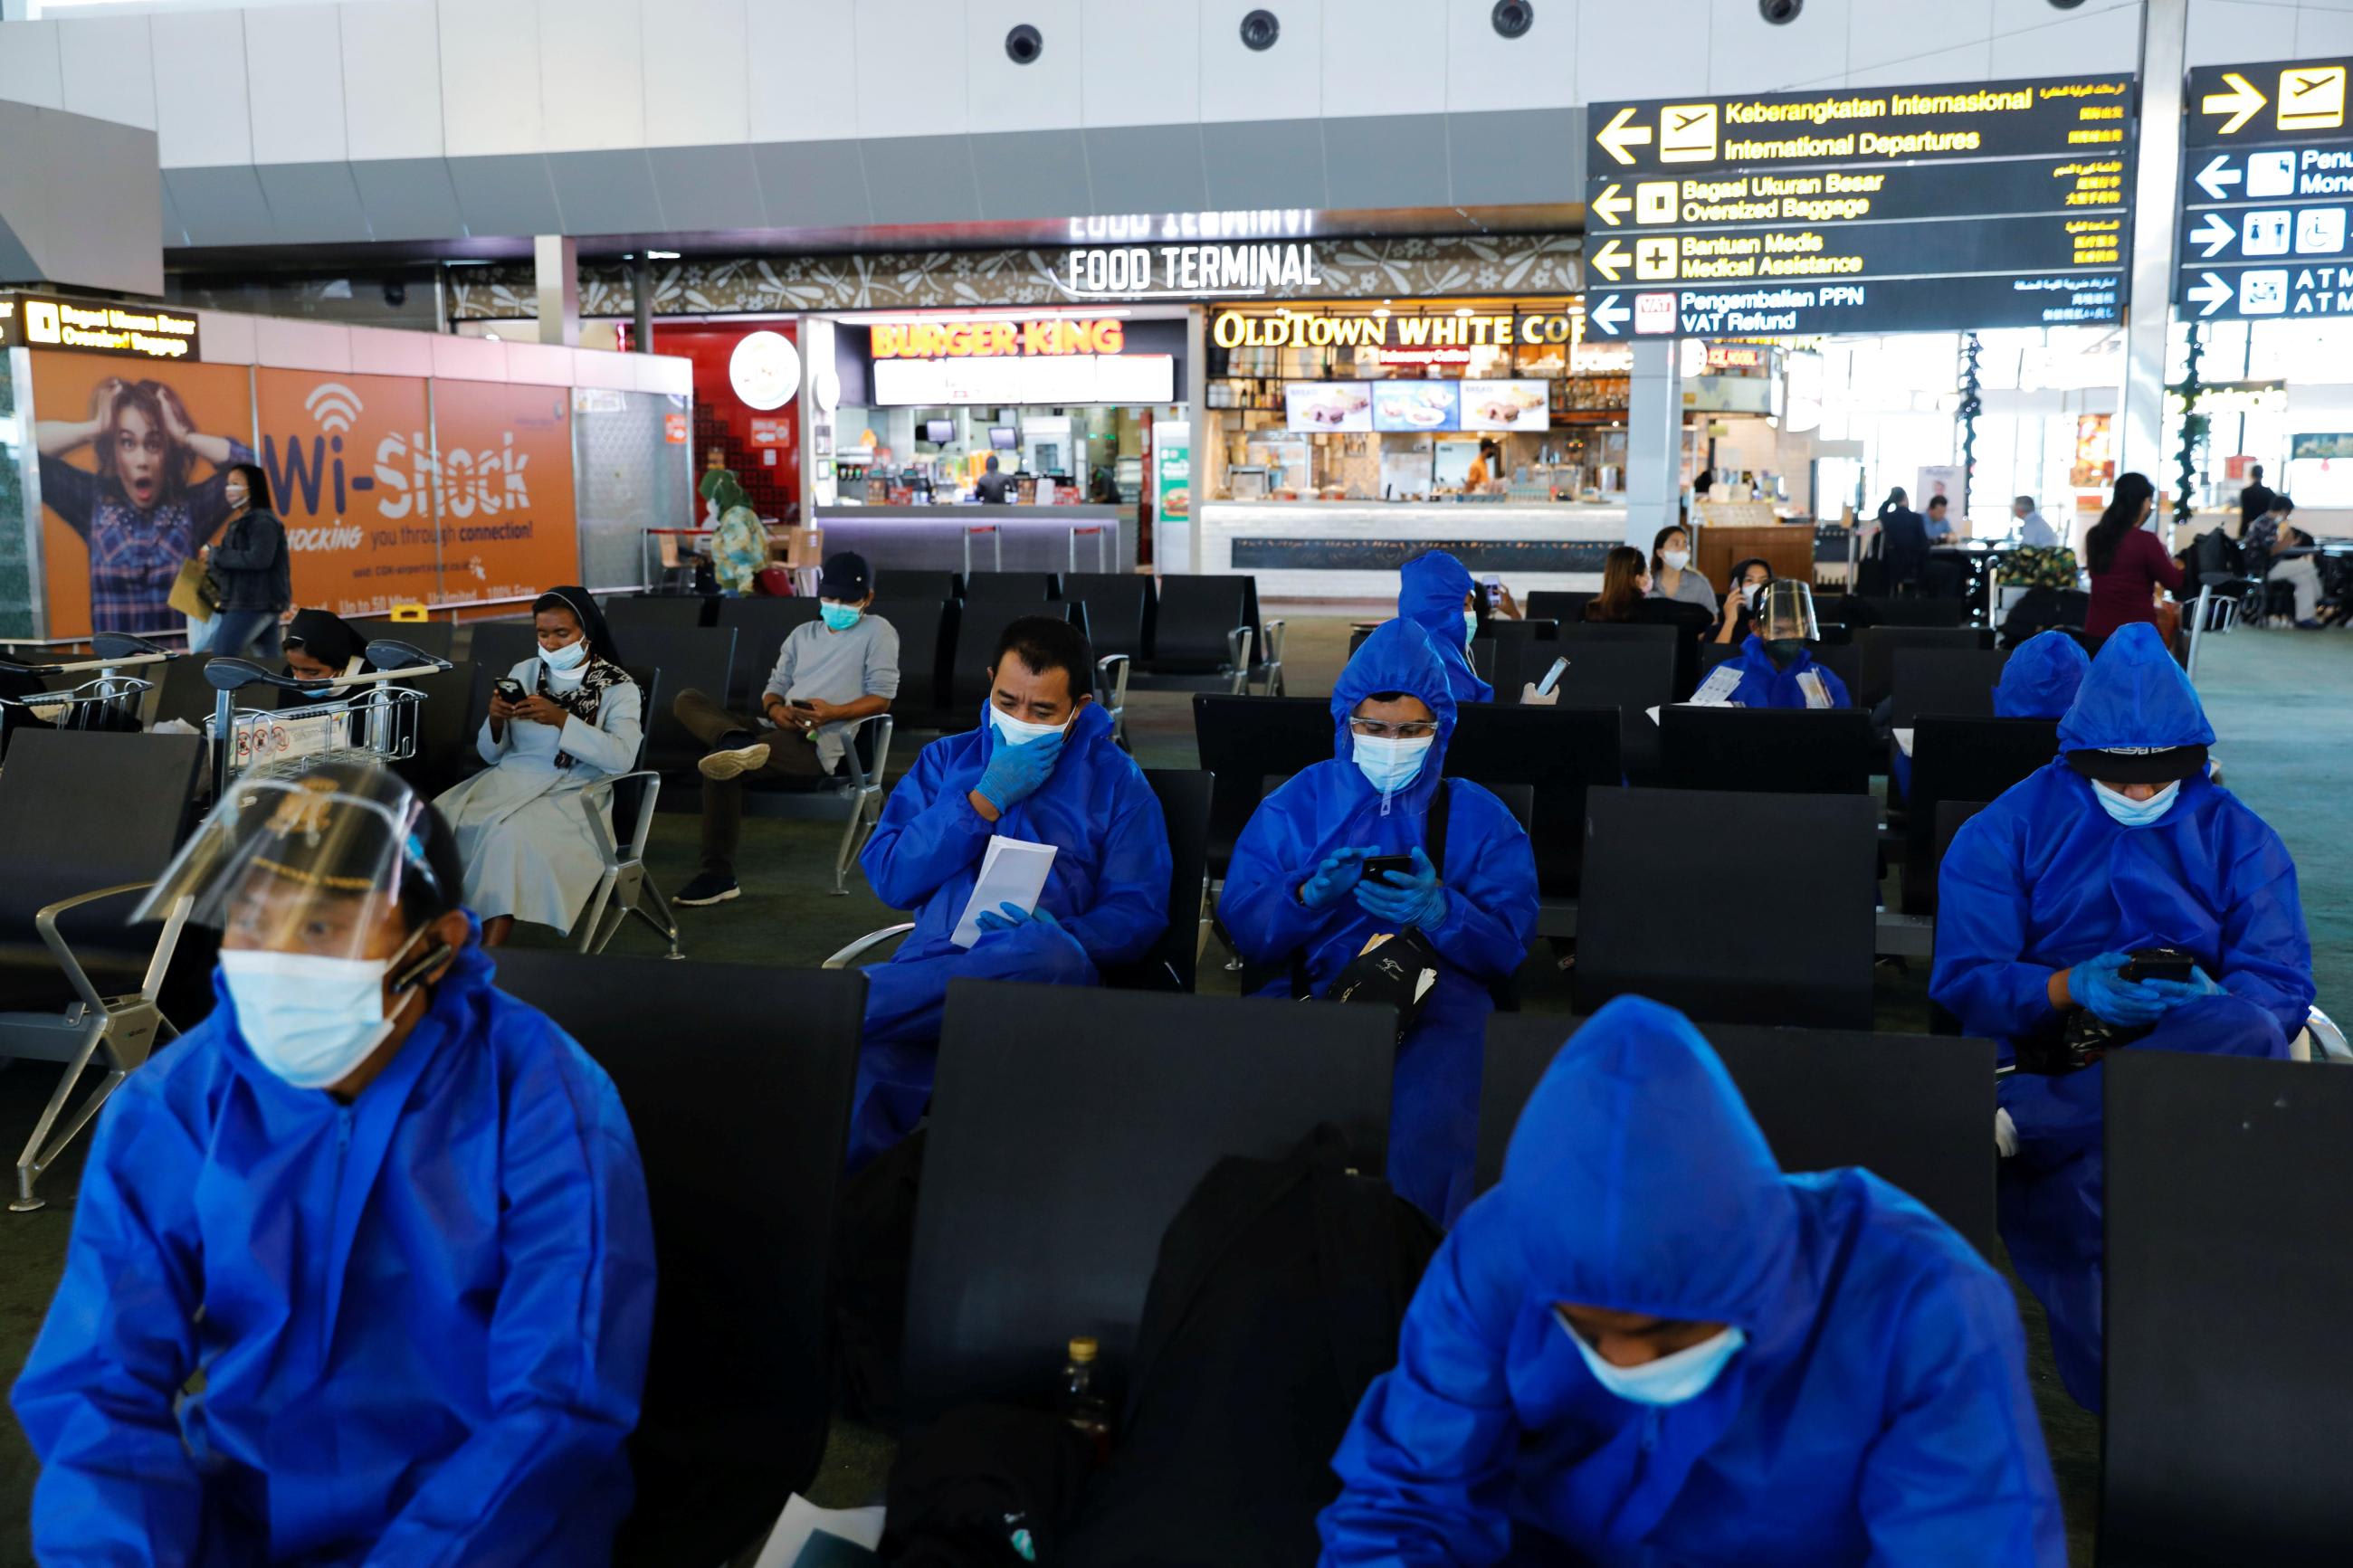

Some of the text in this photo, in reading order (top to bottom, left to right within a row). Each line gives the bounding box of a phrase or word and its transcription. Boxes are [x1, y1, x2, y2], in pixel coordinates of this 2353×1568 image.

[1726, 98, 1885, 124] Keberangkatan
[1891, 87, 2033, 116] Internasional
[1725, 131, 1980, 160] International Departures
[1682, 173, 1885, 203] Bagasi Ukuran Besar
[1682, 197, 1870, 223] Oversized Baggage
[1682, 233, 1824, 256] Bantuan Medis
[1069, 243, 1322, 291] FOOD TERMINAL
[1681, 255, 1862, 278] Medical Assistance
[1681, 286, 1864, 314] Pengembalian PPN
[1396, 314, 1513, 346] WHITE
[1681, 310, 1796, 333] VAT Refund
[871, 318, 1125, 358] BURGER KING
[264, 430, 531, 518] Wi-Shock
[371, 529, 396, 550] you
[401, 526, 454, 546] through
[459, 520, 534, 542] connection!
